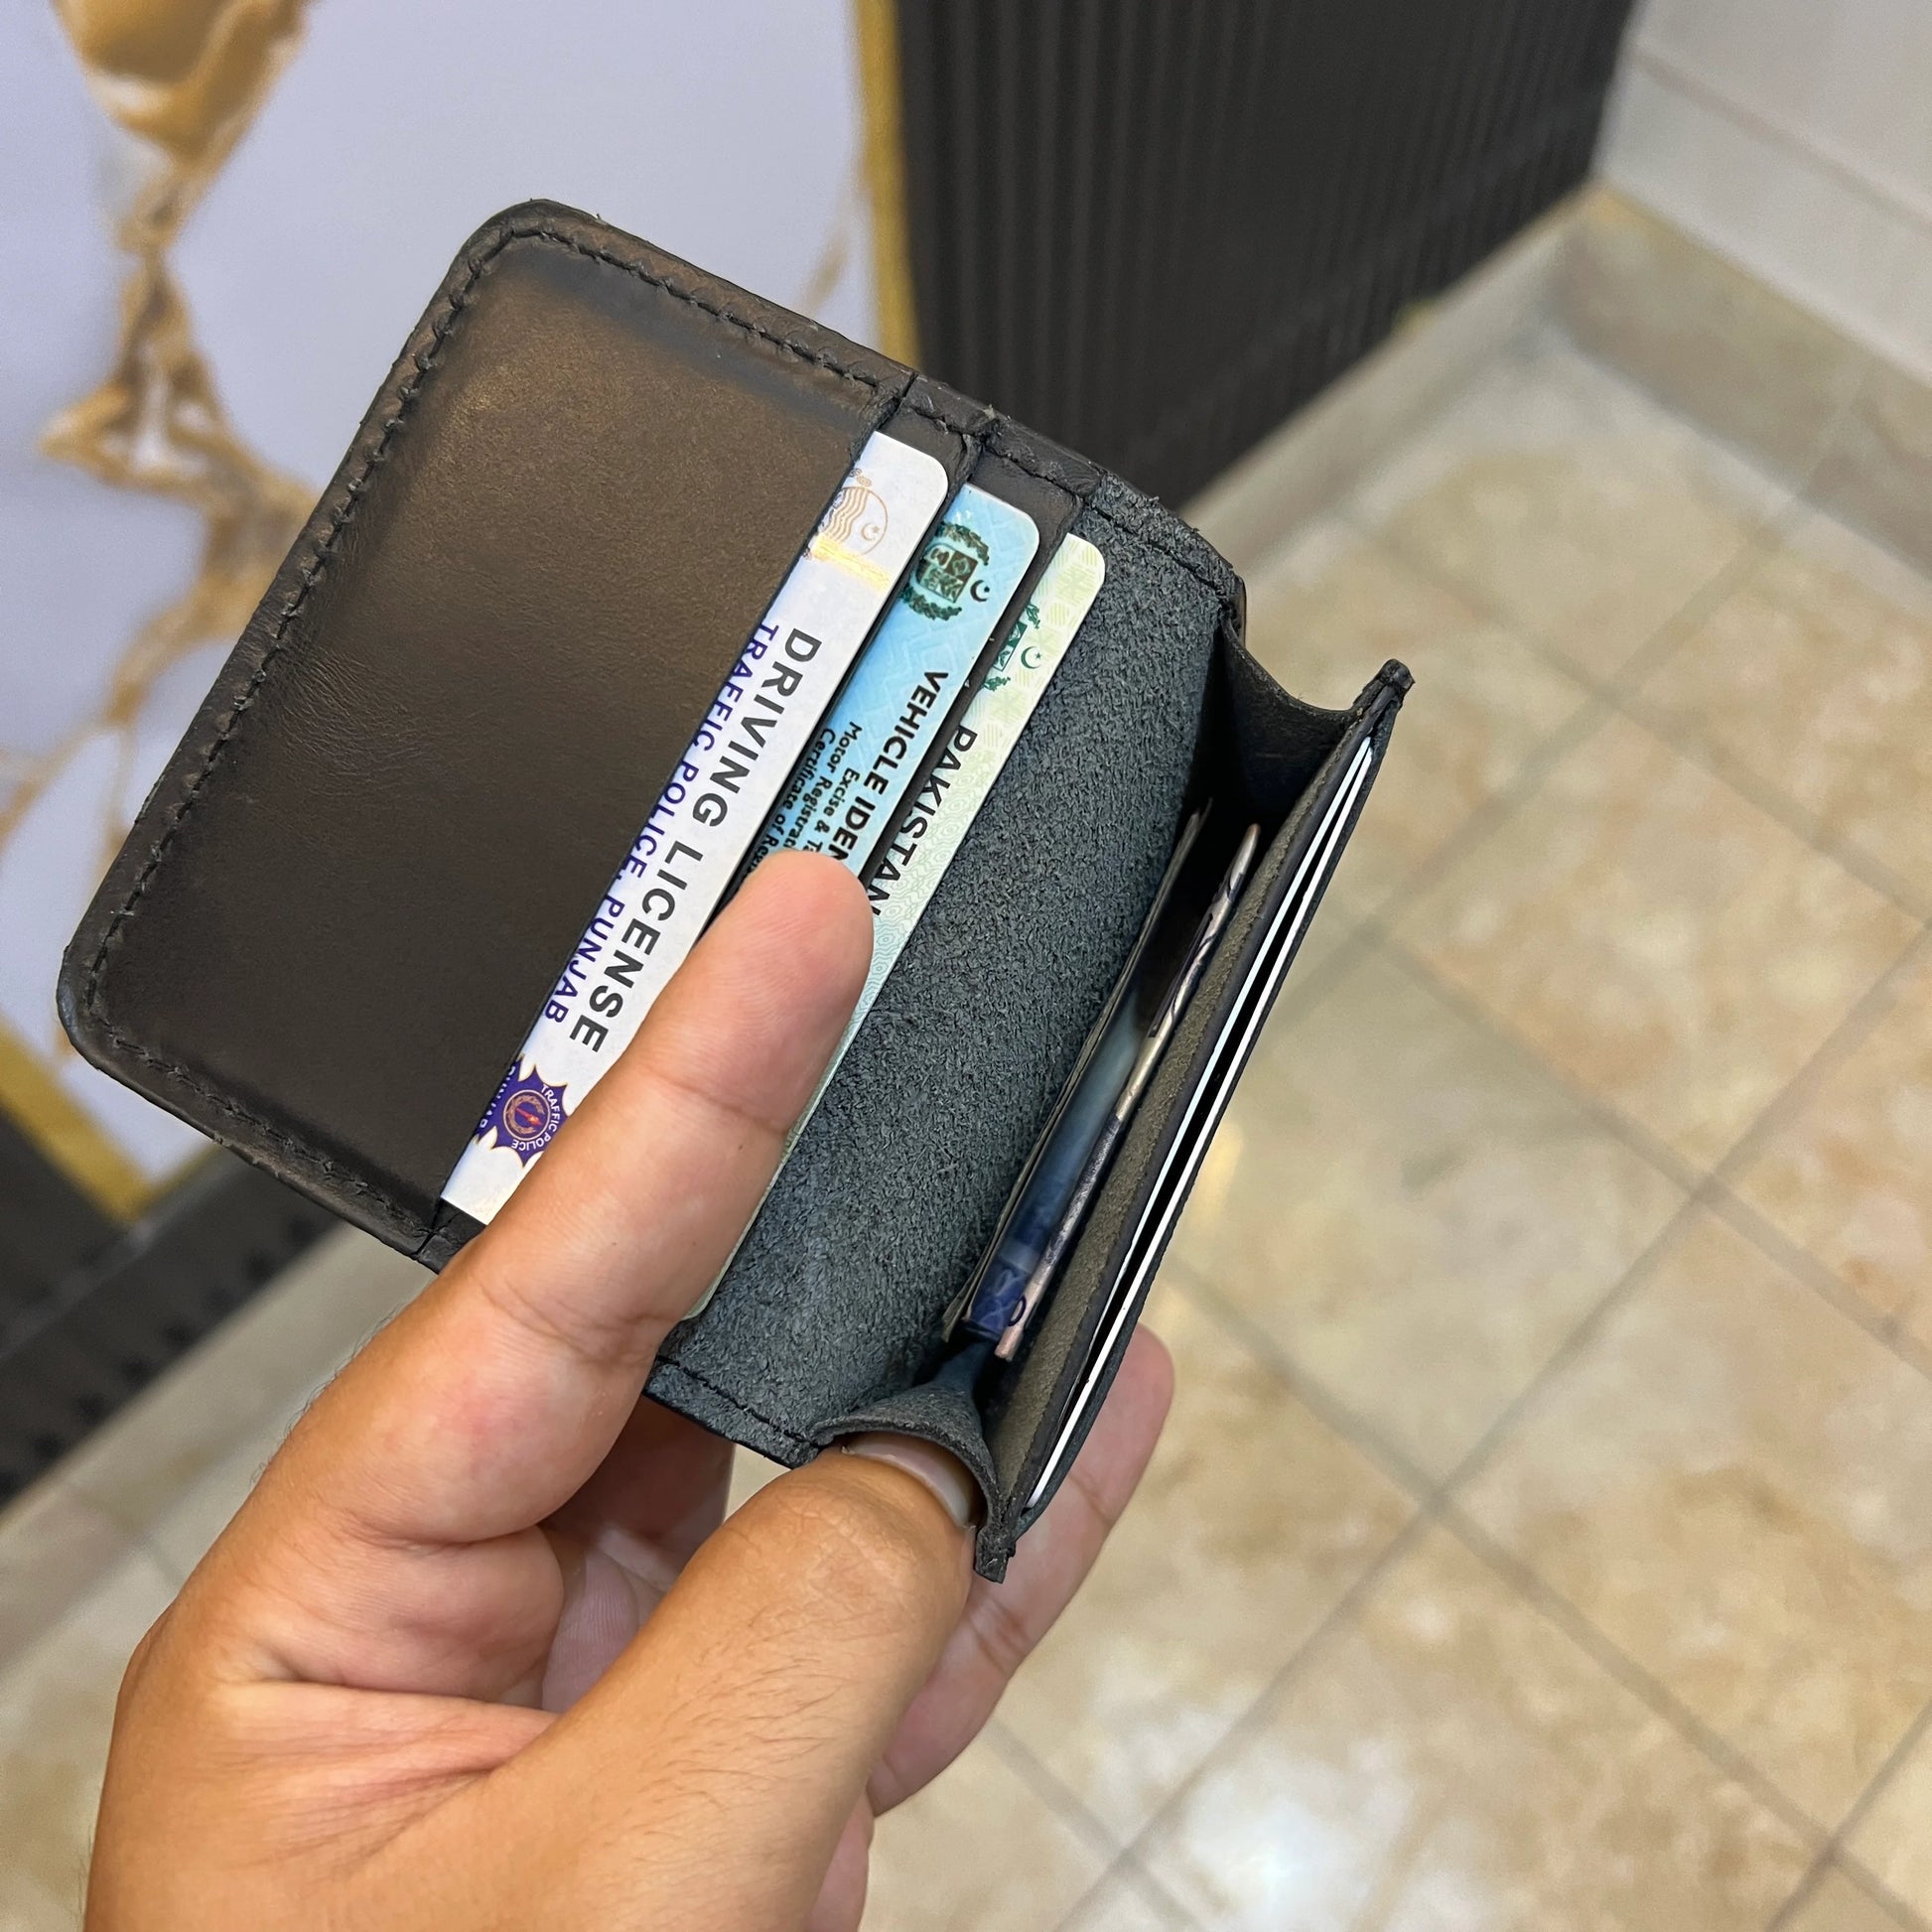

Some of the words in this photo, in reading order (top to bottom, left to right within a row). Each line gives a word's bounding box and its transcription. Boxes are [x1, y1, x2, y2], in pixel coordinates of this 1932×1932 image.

[692, 622, 779, 752] TRAFFIC
[692, 627, 823, 827] DRIVING
[827, 721, 863, 773] Motor
[864, 672, 949, 795] VEHICLE
[782, 728, 836, 810] Certificate
[823, 767, 861, 818] Excise
[769, 814, 786, 836] of
[814, 819, 830, 833] &
[827, 796, 876, 861] IDEN
[866, 725, 978, 916] PAKISTAN
[544, 894, 625, 1023] PUNJAB
[569, 840, 703, 1052] LICENSE
[511, 1132, 551, 1152] POLICE
[541, 1083, 561, 1132] TRAFFIC
